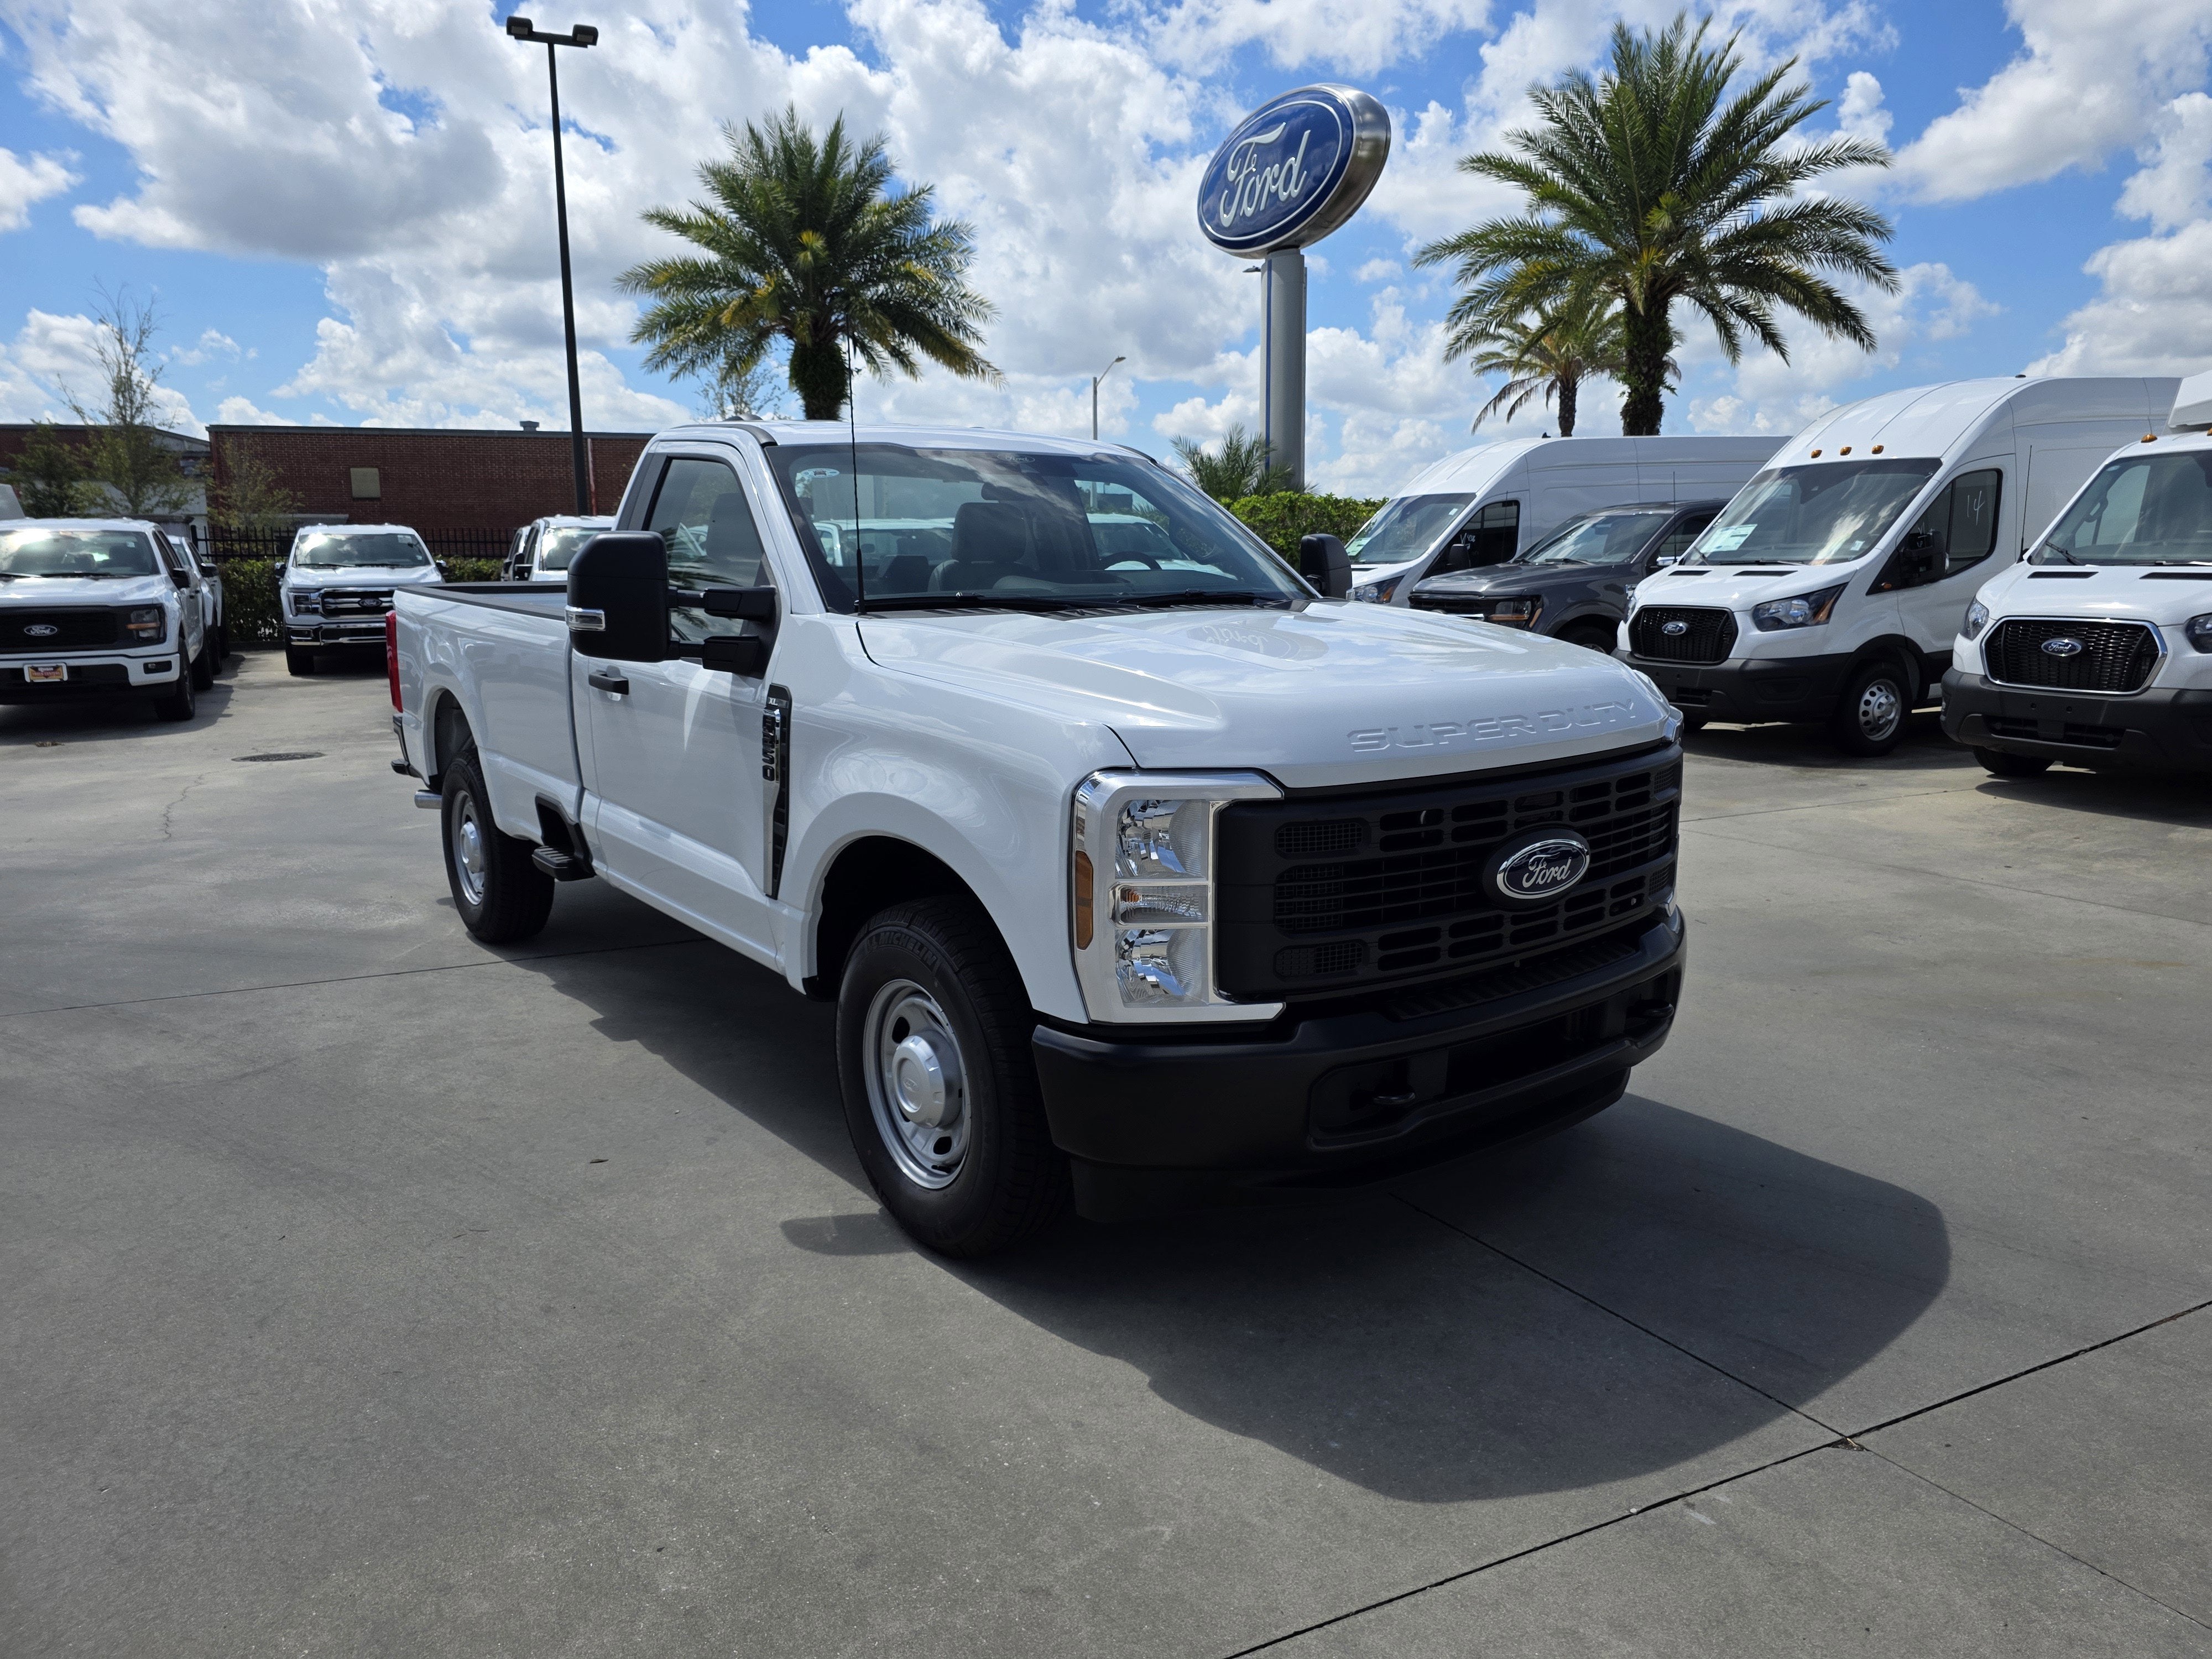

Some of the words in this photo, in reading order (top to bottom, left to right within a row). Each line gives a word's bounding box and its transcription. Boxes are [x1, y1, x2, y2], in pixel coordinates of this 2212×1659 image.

[1220, 122, 1311, 227] Ford
[1967, 491, 1985, 525] 14
[2048, 642, 2072, 651] Ford
[768, 697, 778, 706] XL
[1347, 713, 1537, 752] SUPER
[1537, 698, 1636, 732] DUTY
[1522, 852, 1572, 888] Ford
[878, 931, 938, 966] MICHELIN
